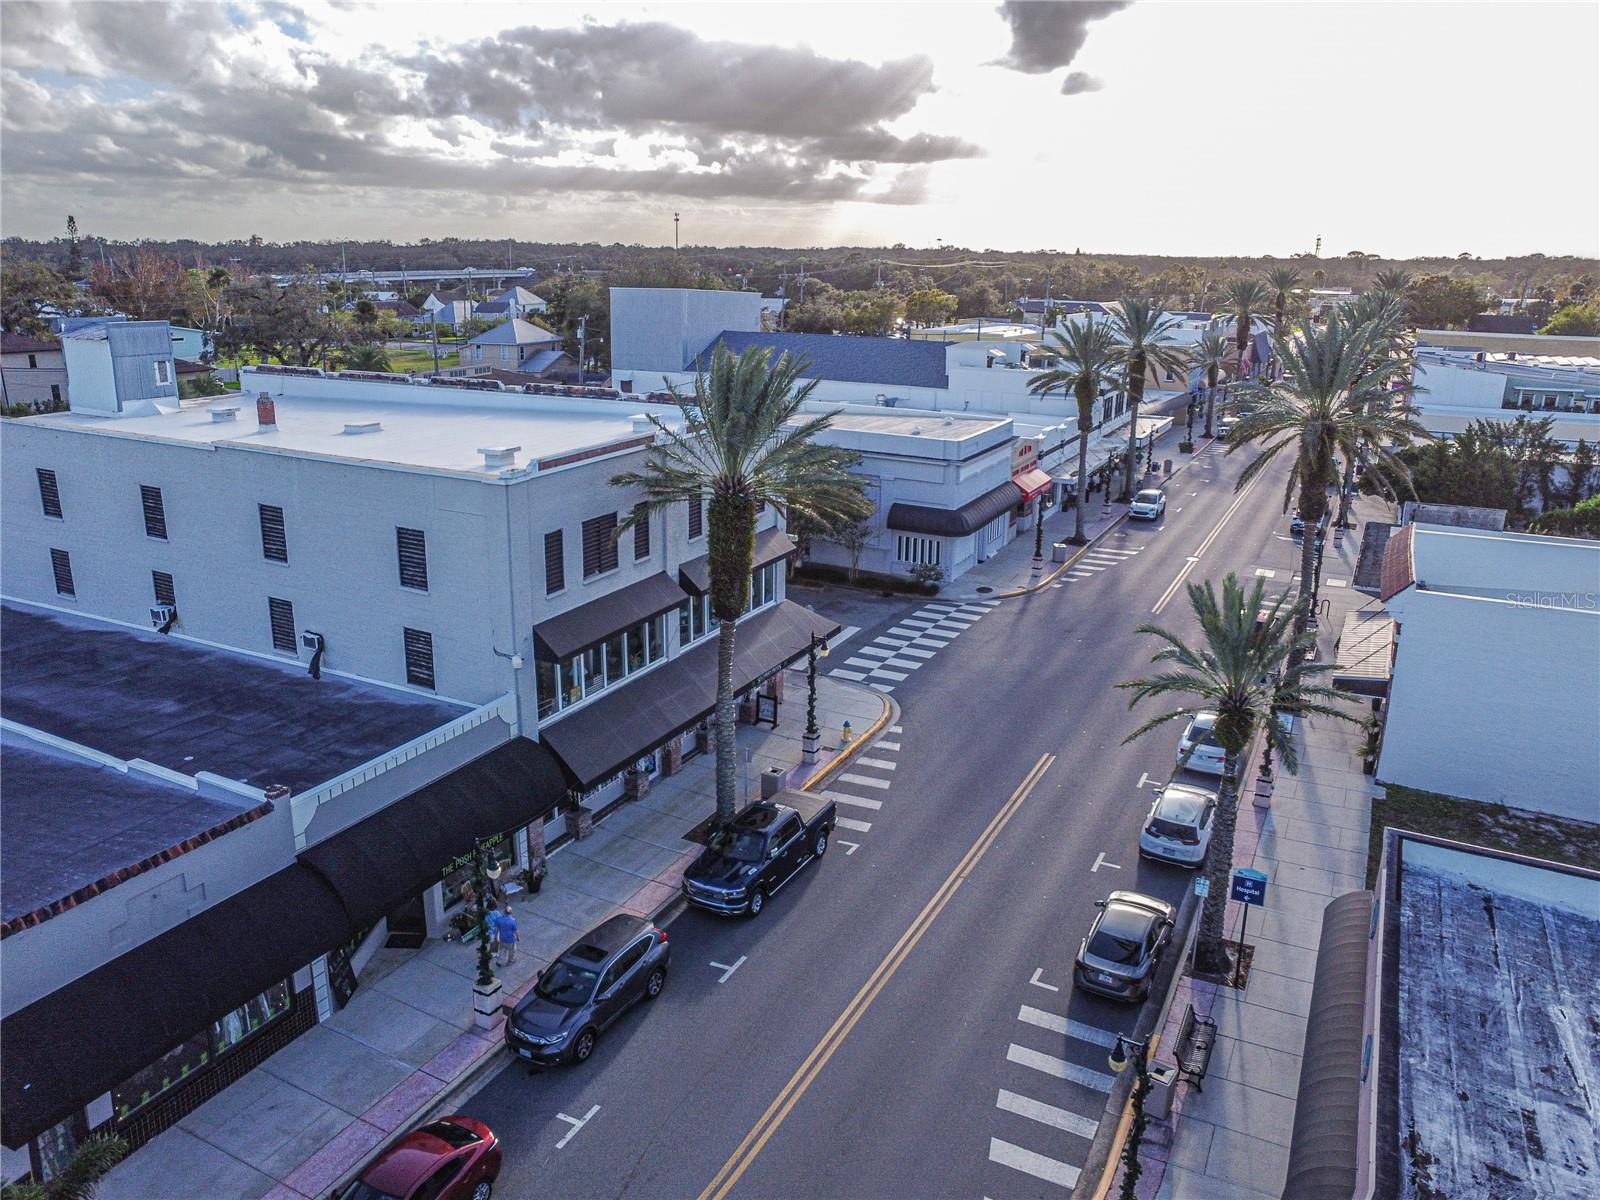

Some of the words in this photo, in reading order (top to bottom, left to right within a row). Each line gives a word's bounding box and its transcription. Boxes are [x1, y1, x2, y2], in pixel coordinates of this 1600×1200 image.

[442, 863, 455, 877] THE
[455, 852, 472, 869] POSH
[1236, 886, 1260, 895] Hospital
